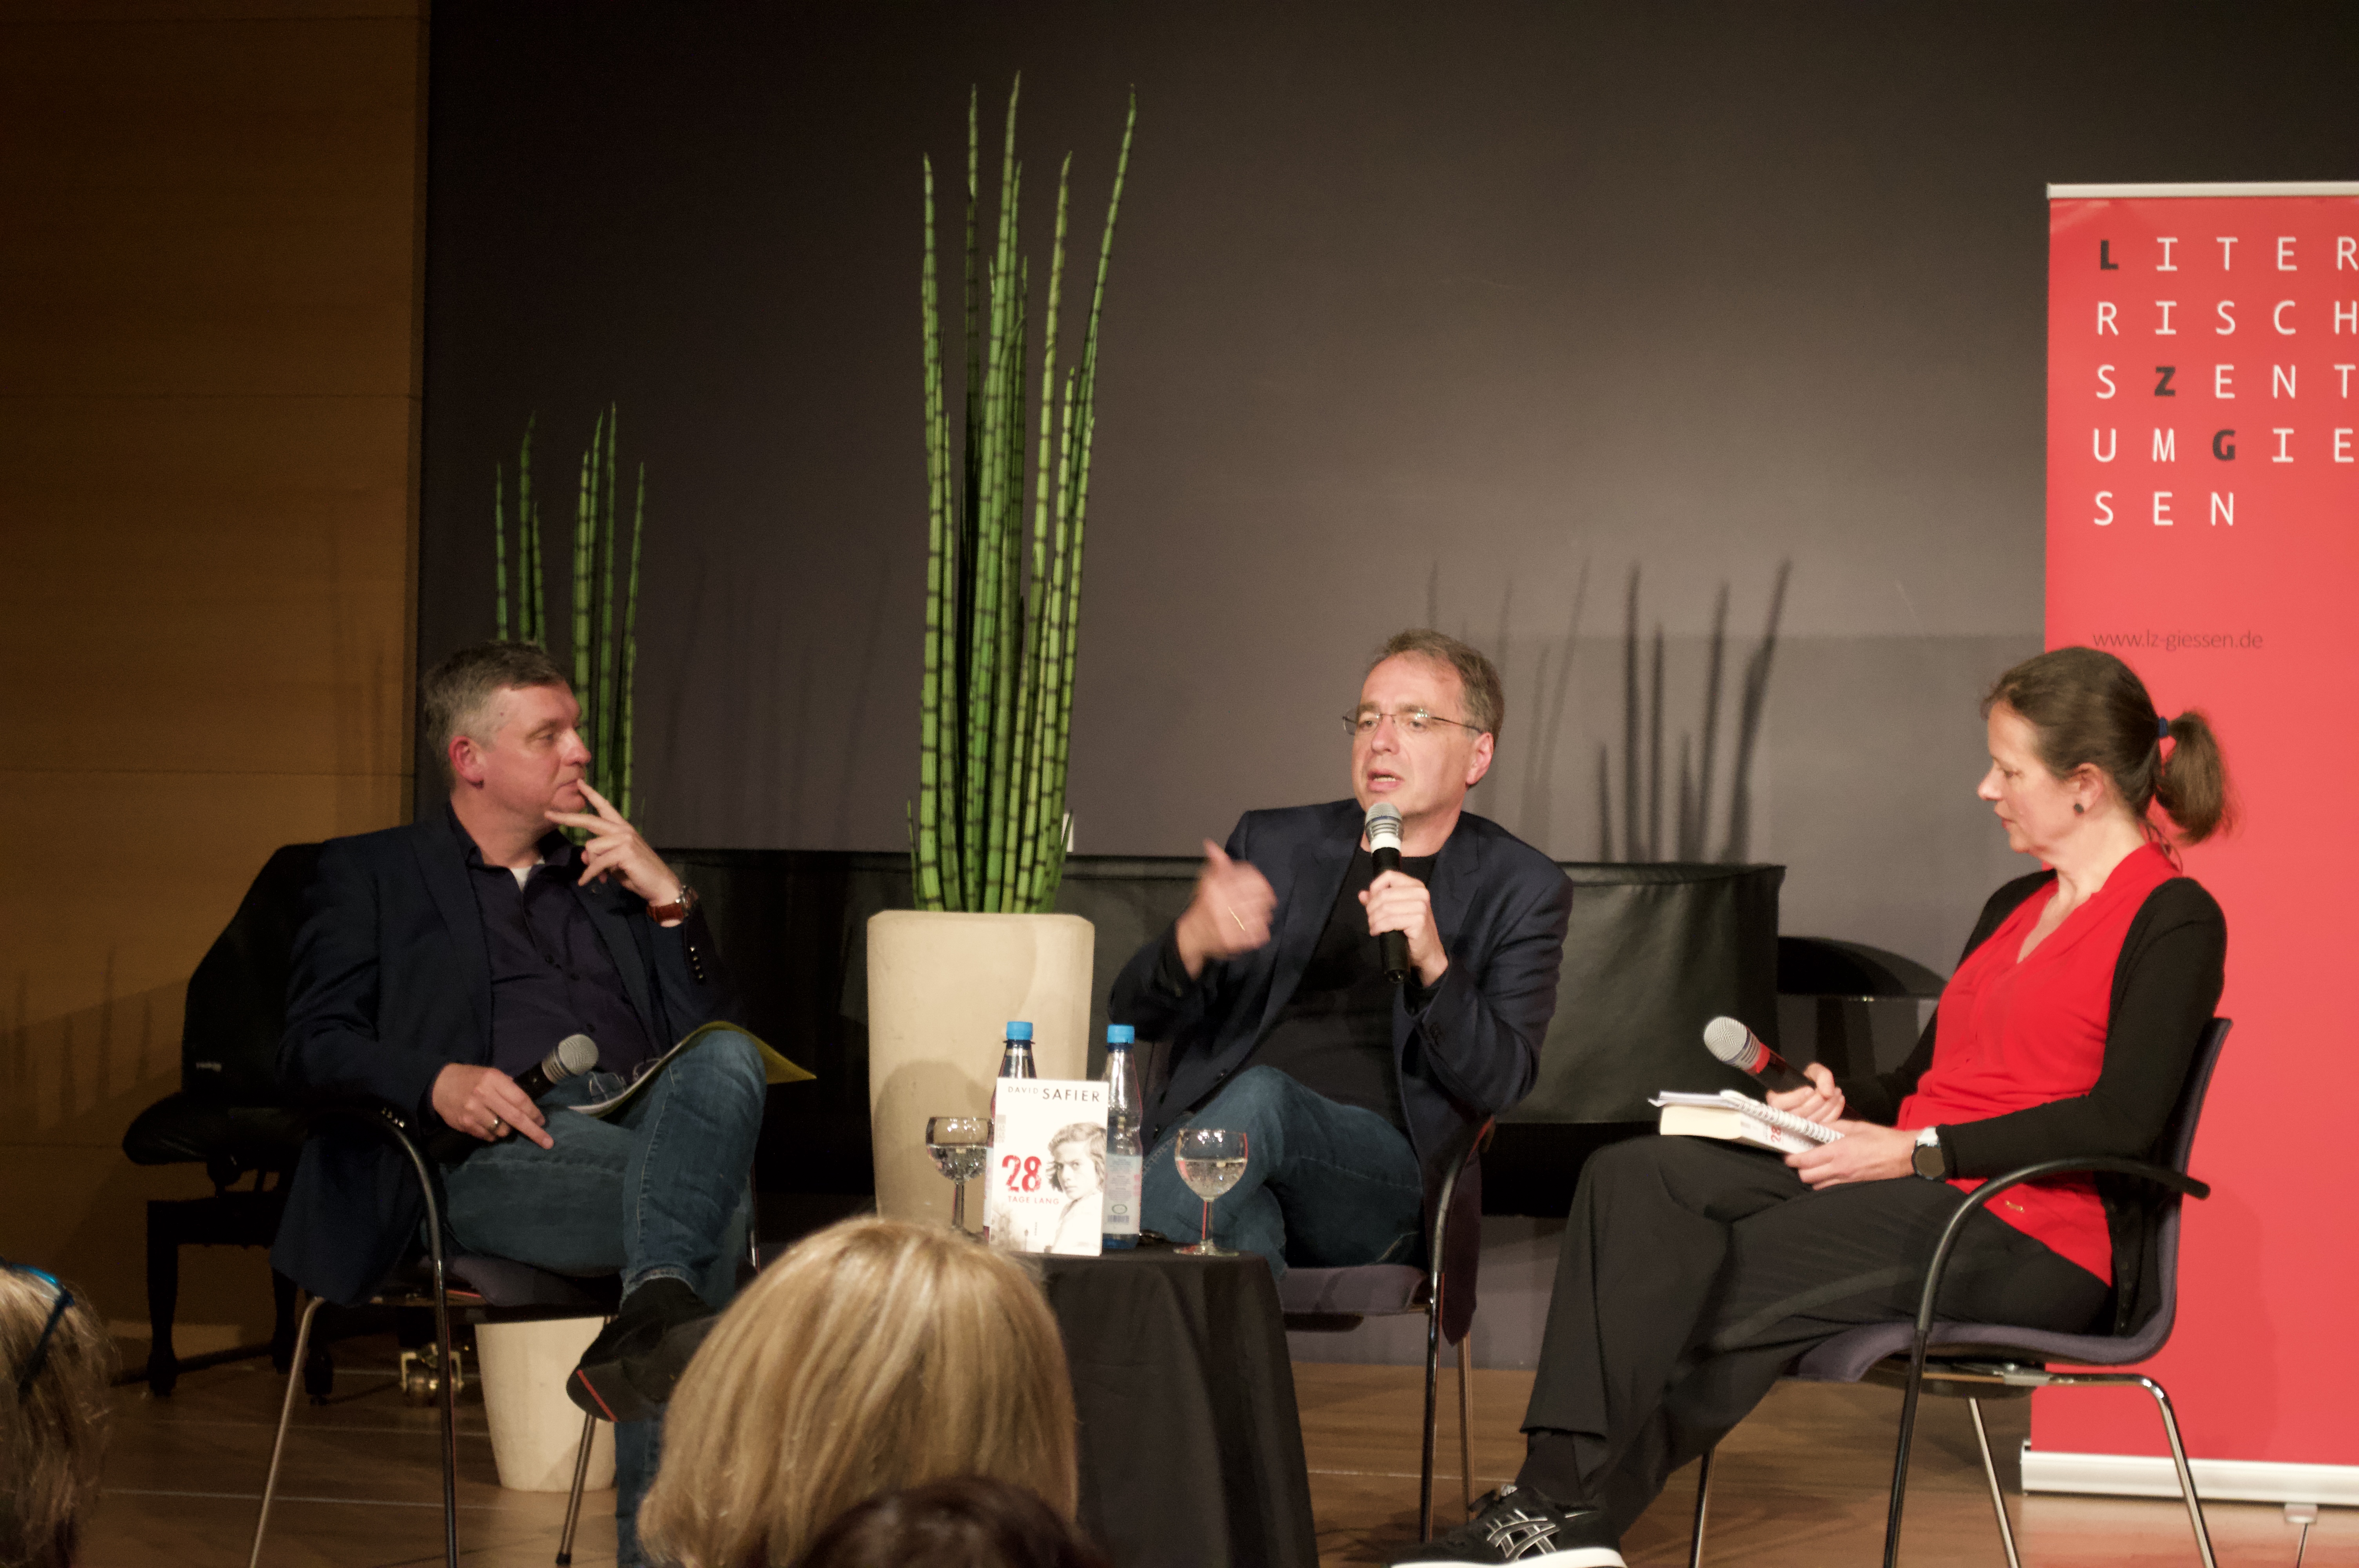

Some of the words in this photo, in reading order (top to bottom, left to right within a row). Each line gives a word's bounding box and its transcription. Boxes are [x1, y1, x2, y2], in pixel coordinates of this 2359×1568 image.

[2097, 300, 2357, 335] RISCH
[2096, 364, 2356, 399] SZENT
[2093, 428, 2354, 463] UMGIE
[2094, 491, 2234, 526] SEN
[2093, 629, 2263, 651] www.lz-giessen.de
[1042, 1088, 1100, 1102] SAFIER
[1001, 1154, 1042, 1193] 28
